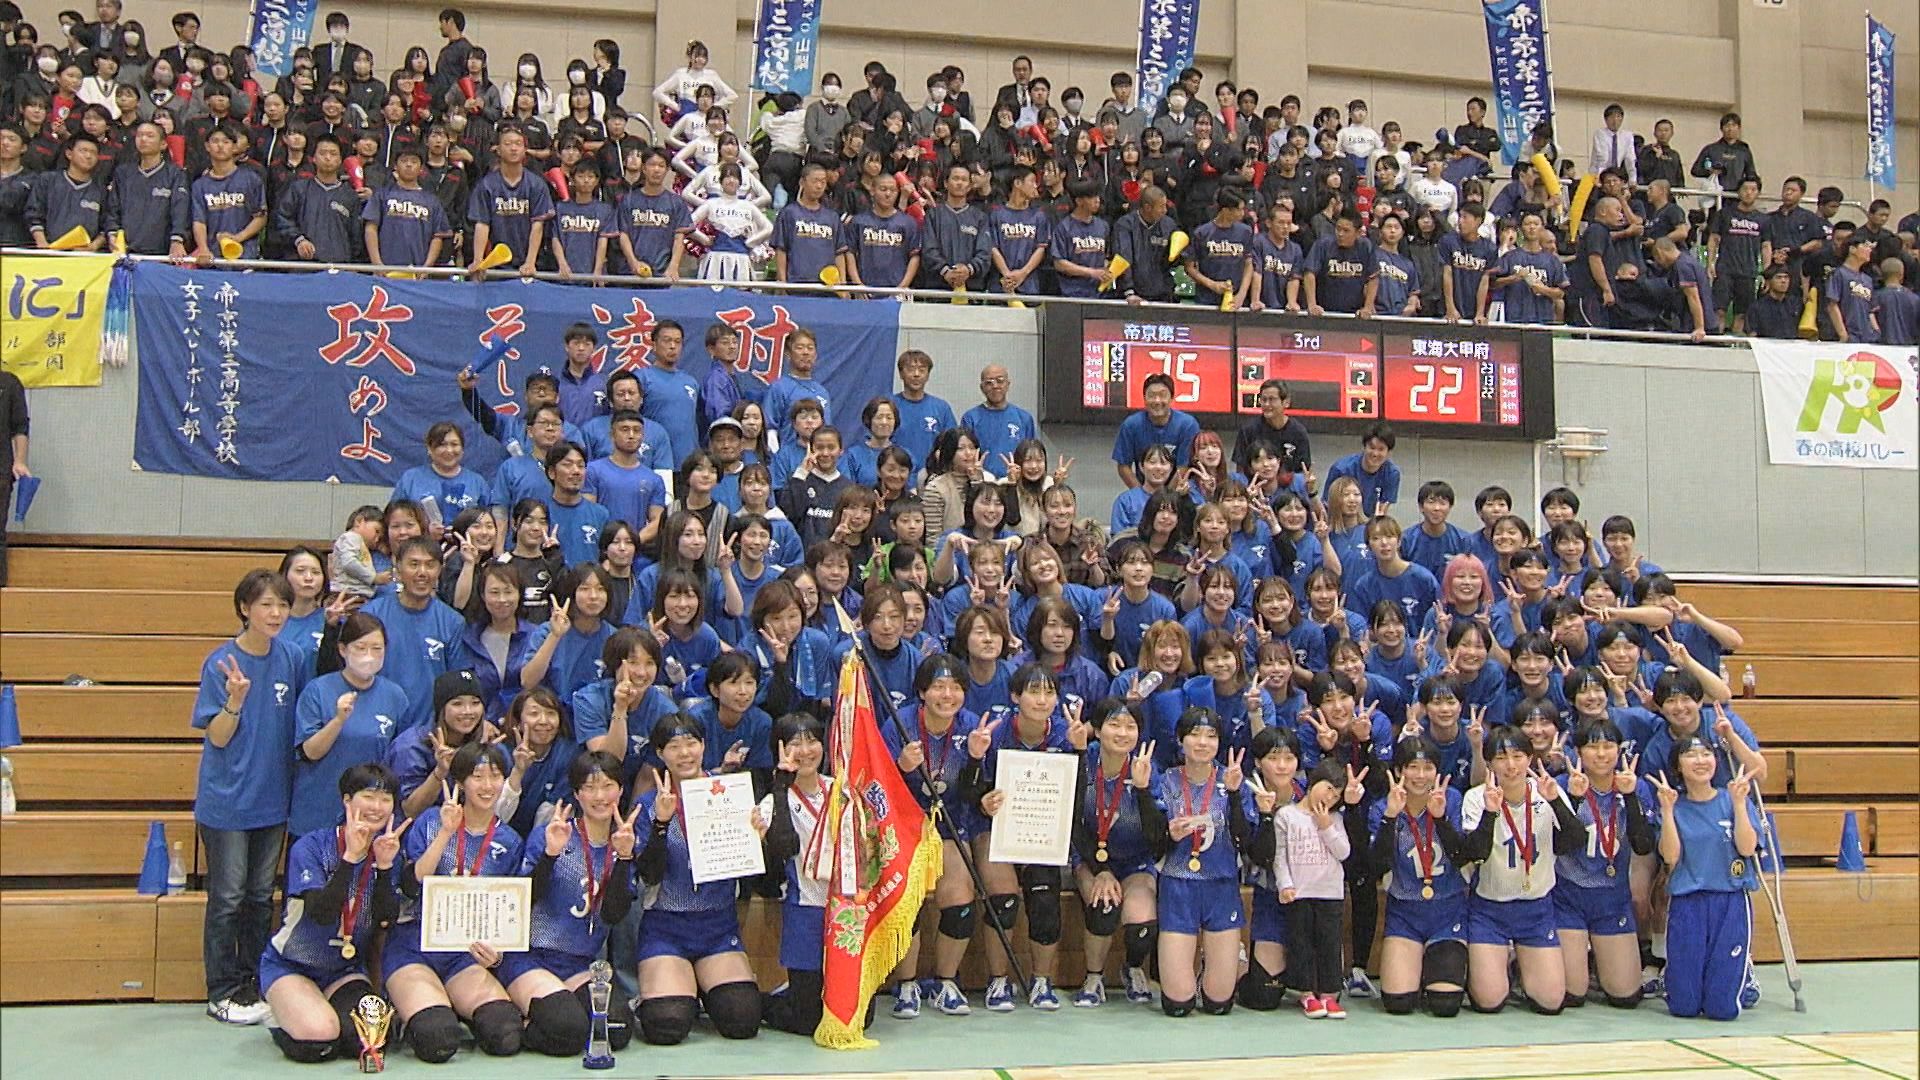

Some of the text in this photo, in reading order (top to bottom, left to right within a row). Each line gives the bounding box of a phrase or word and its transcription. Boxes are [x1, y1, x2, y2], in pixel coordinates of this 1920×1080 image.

[760, 0, 793, 91] 三高校
[1495, 46, 1513, 109] TEIKYO
[1506, 3, 1547, 140] 帝京第三高
[205, 192, 245, 206] Teikyo
[387, 199, 429, 217] Teikyo
[632, 208, 670, 226] Teikyo
[863, 227, 903, 246] Teikyo
[1206, 239, 1244, 257] Teikyo
[1327, 259, 1363, 275] Teikyo
[1124, 323, 1191, 342] 帝京第三
[1293, 333, 1321, 350] 3rd
[1086, 343, 1102, 353] 1st
[1411, 339, 1490, 359] 東海大甲府
[178, 279, 205, 444] 女子バレーボール部
[479, 303, 526, 415] そし
[1085, 357, 1103, 366] 2nd
[214, 281, 241, 466] 帝京第三高等学校
[318, 284, 416, 464] 攻めよ
[1248, 365, 1257, 380] 2
[1356, 371, 1366, 386] 2
[1503, 366, 1516, 375] 1st
[1484, 375, 1494, 386] 13
[1410, 365, 1463, 415] 22
[1481, 387, 1494, 399] 22
[1357, 398, 1366, 414] 2
[1796, 439, 1905, 460] 春の高校バレー
[1406, 841, 1445, 878] 12
[570, 878, 600, 918] 3
